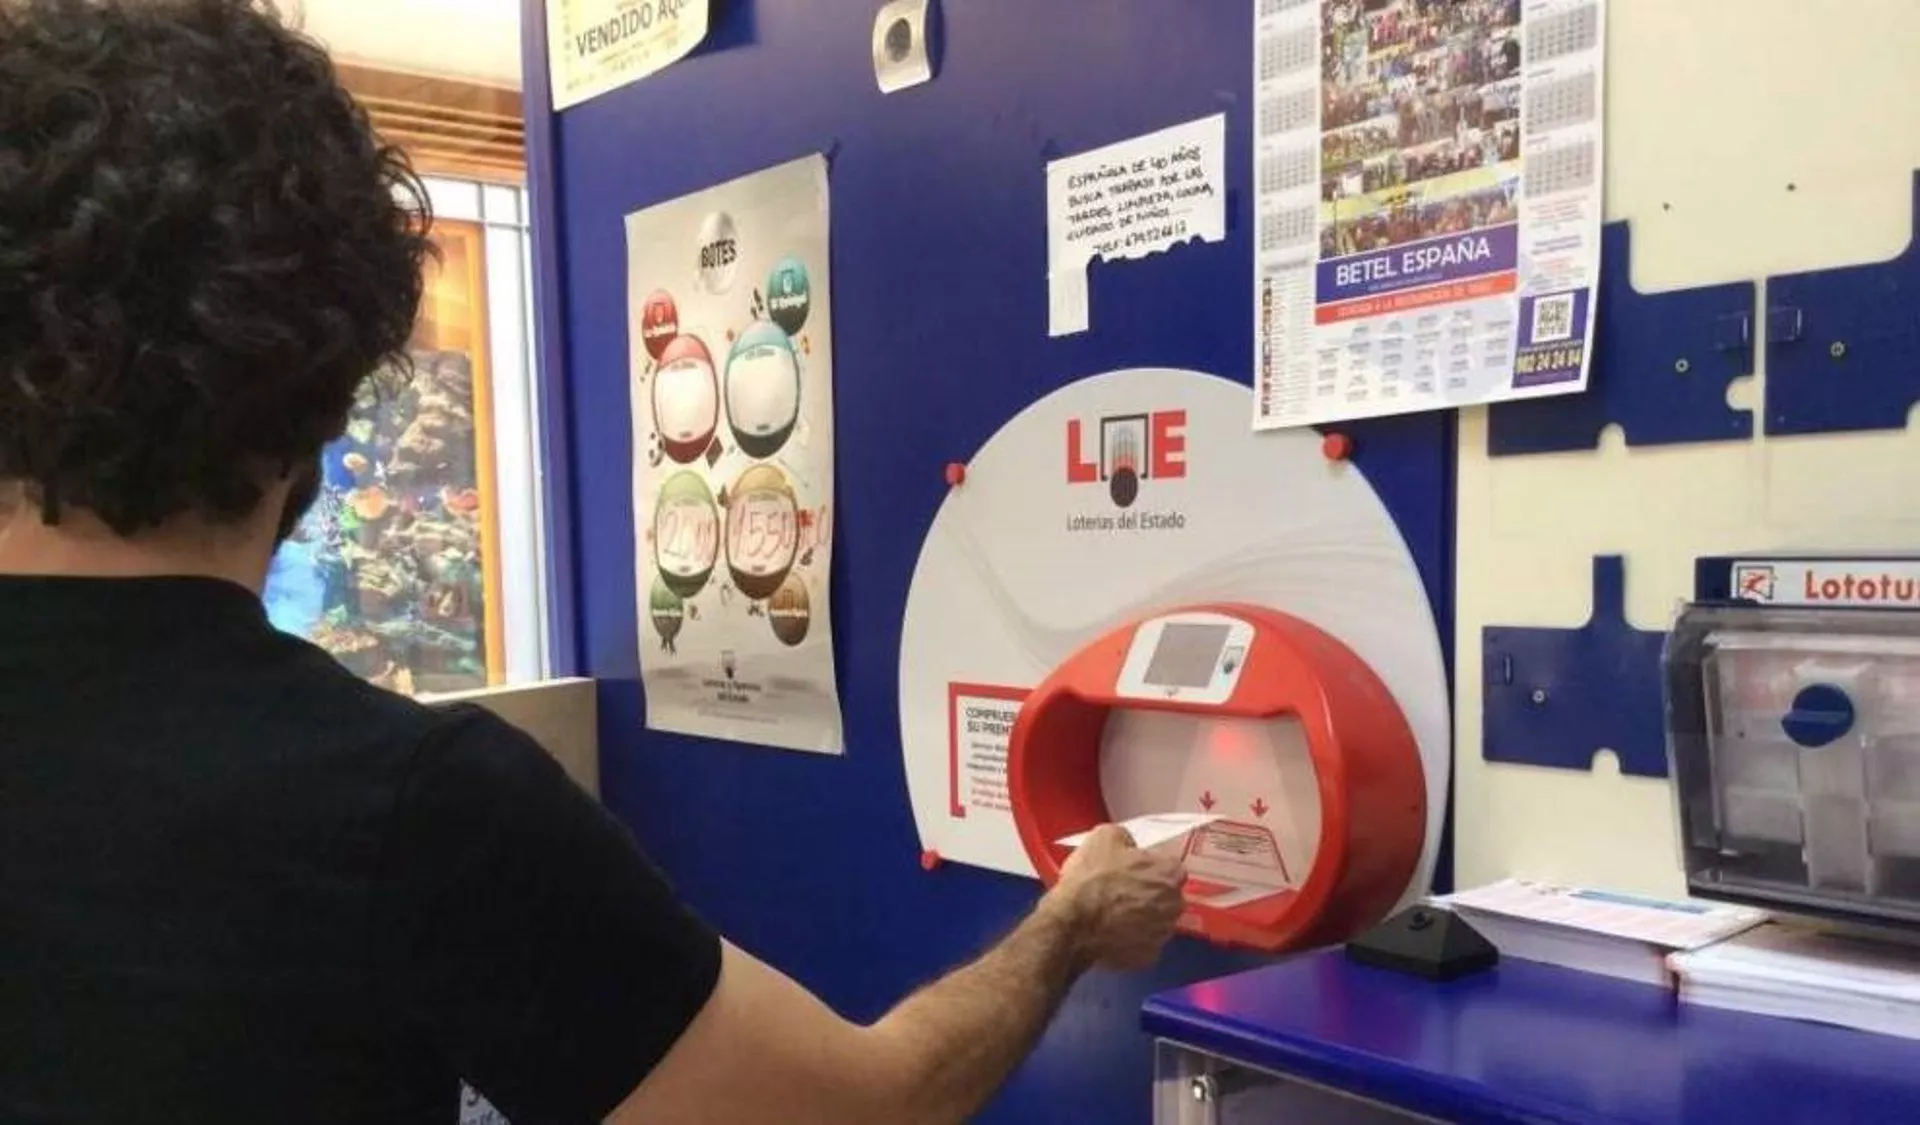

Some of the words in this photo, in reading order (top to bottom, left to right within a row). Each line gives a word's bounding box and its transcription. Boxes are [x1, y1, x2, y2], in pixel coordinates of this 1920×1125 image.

[576, 2, 652, 56] VENDIDO
[1132, 160, 1147, 172] DE
[1170, 146, 1201, 162] AÑOS
[1067, 191, 1103, 208] BUSCA
[1160, 173, 1180, 187] POR
[1185, 166, 1203, 181] LAS
[1119, 213, 1133, 227] DE
[701, 238, 737, 269] BOTES
[1336, 257, 1397, 287] BETEL
[1402, 236, 1491, 275] ESPAÑA
[1117, 511, 1137, 529] del
[1140, 511, 1186, 529] Estado
[1804, 570, 1920, 600] Lototu
